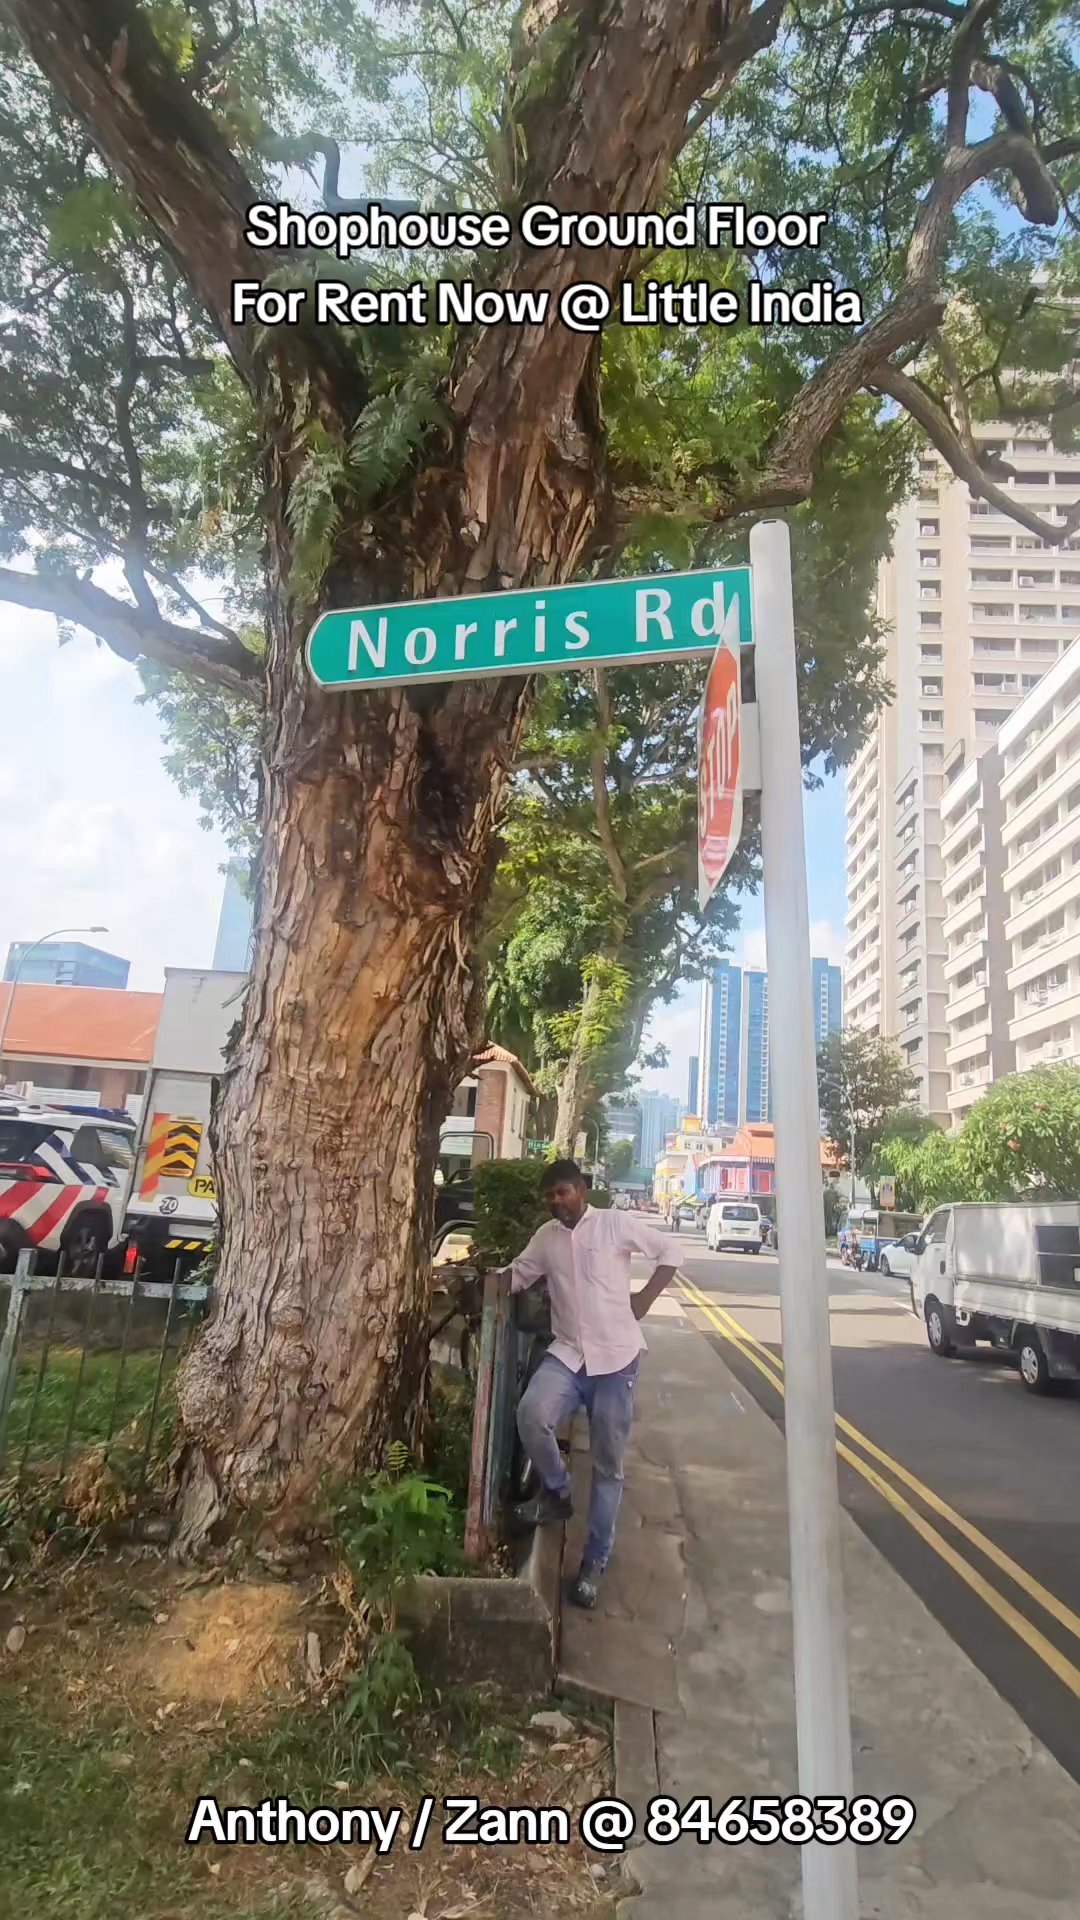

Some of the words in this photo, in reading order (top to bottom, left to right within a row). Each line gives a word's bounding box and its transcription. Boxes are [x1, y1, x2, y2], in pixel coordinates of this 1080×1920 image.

[347, 600, 590, 671] Norris
[635, 581, 725, 643] Rd
[700, 680, 737, 839] STOP
[161, 1199, 178, 1210] 70
